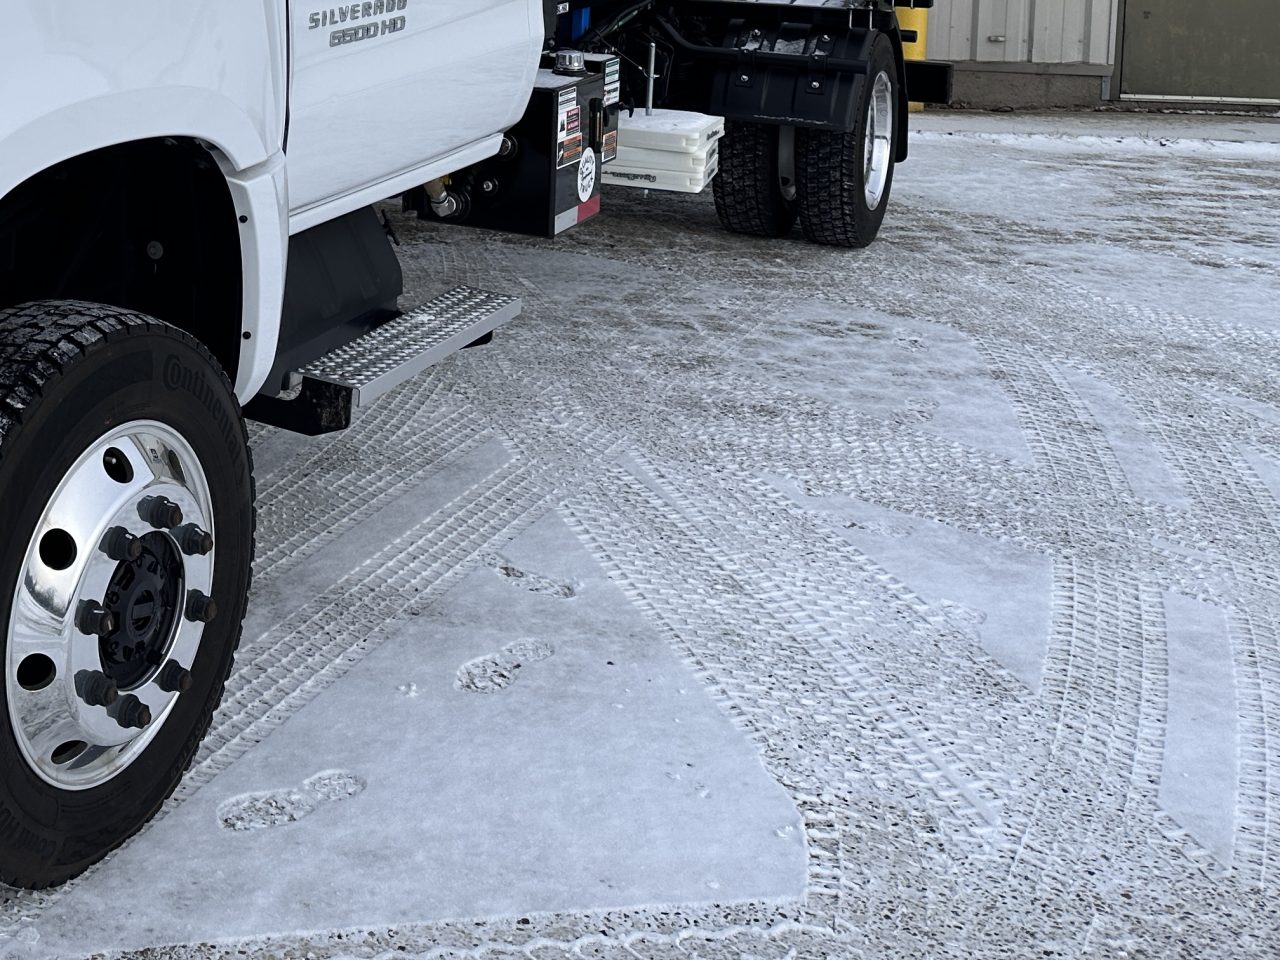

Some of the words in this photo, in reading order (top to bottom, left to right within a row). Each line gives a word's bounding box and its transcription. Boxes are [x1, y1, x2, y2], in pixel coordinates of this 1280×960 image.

[329, 22, 379, 47] 6500
[380, 15, 406, 35] HD
[163, 353, 245, 490] Continental
